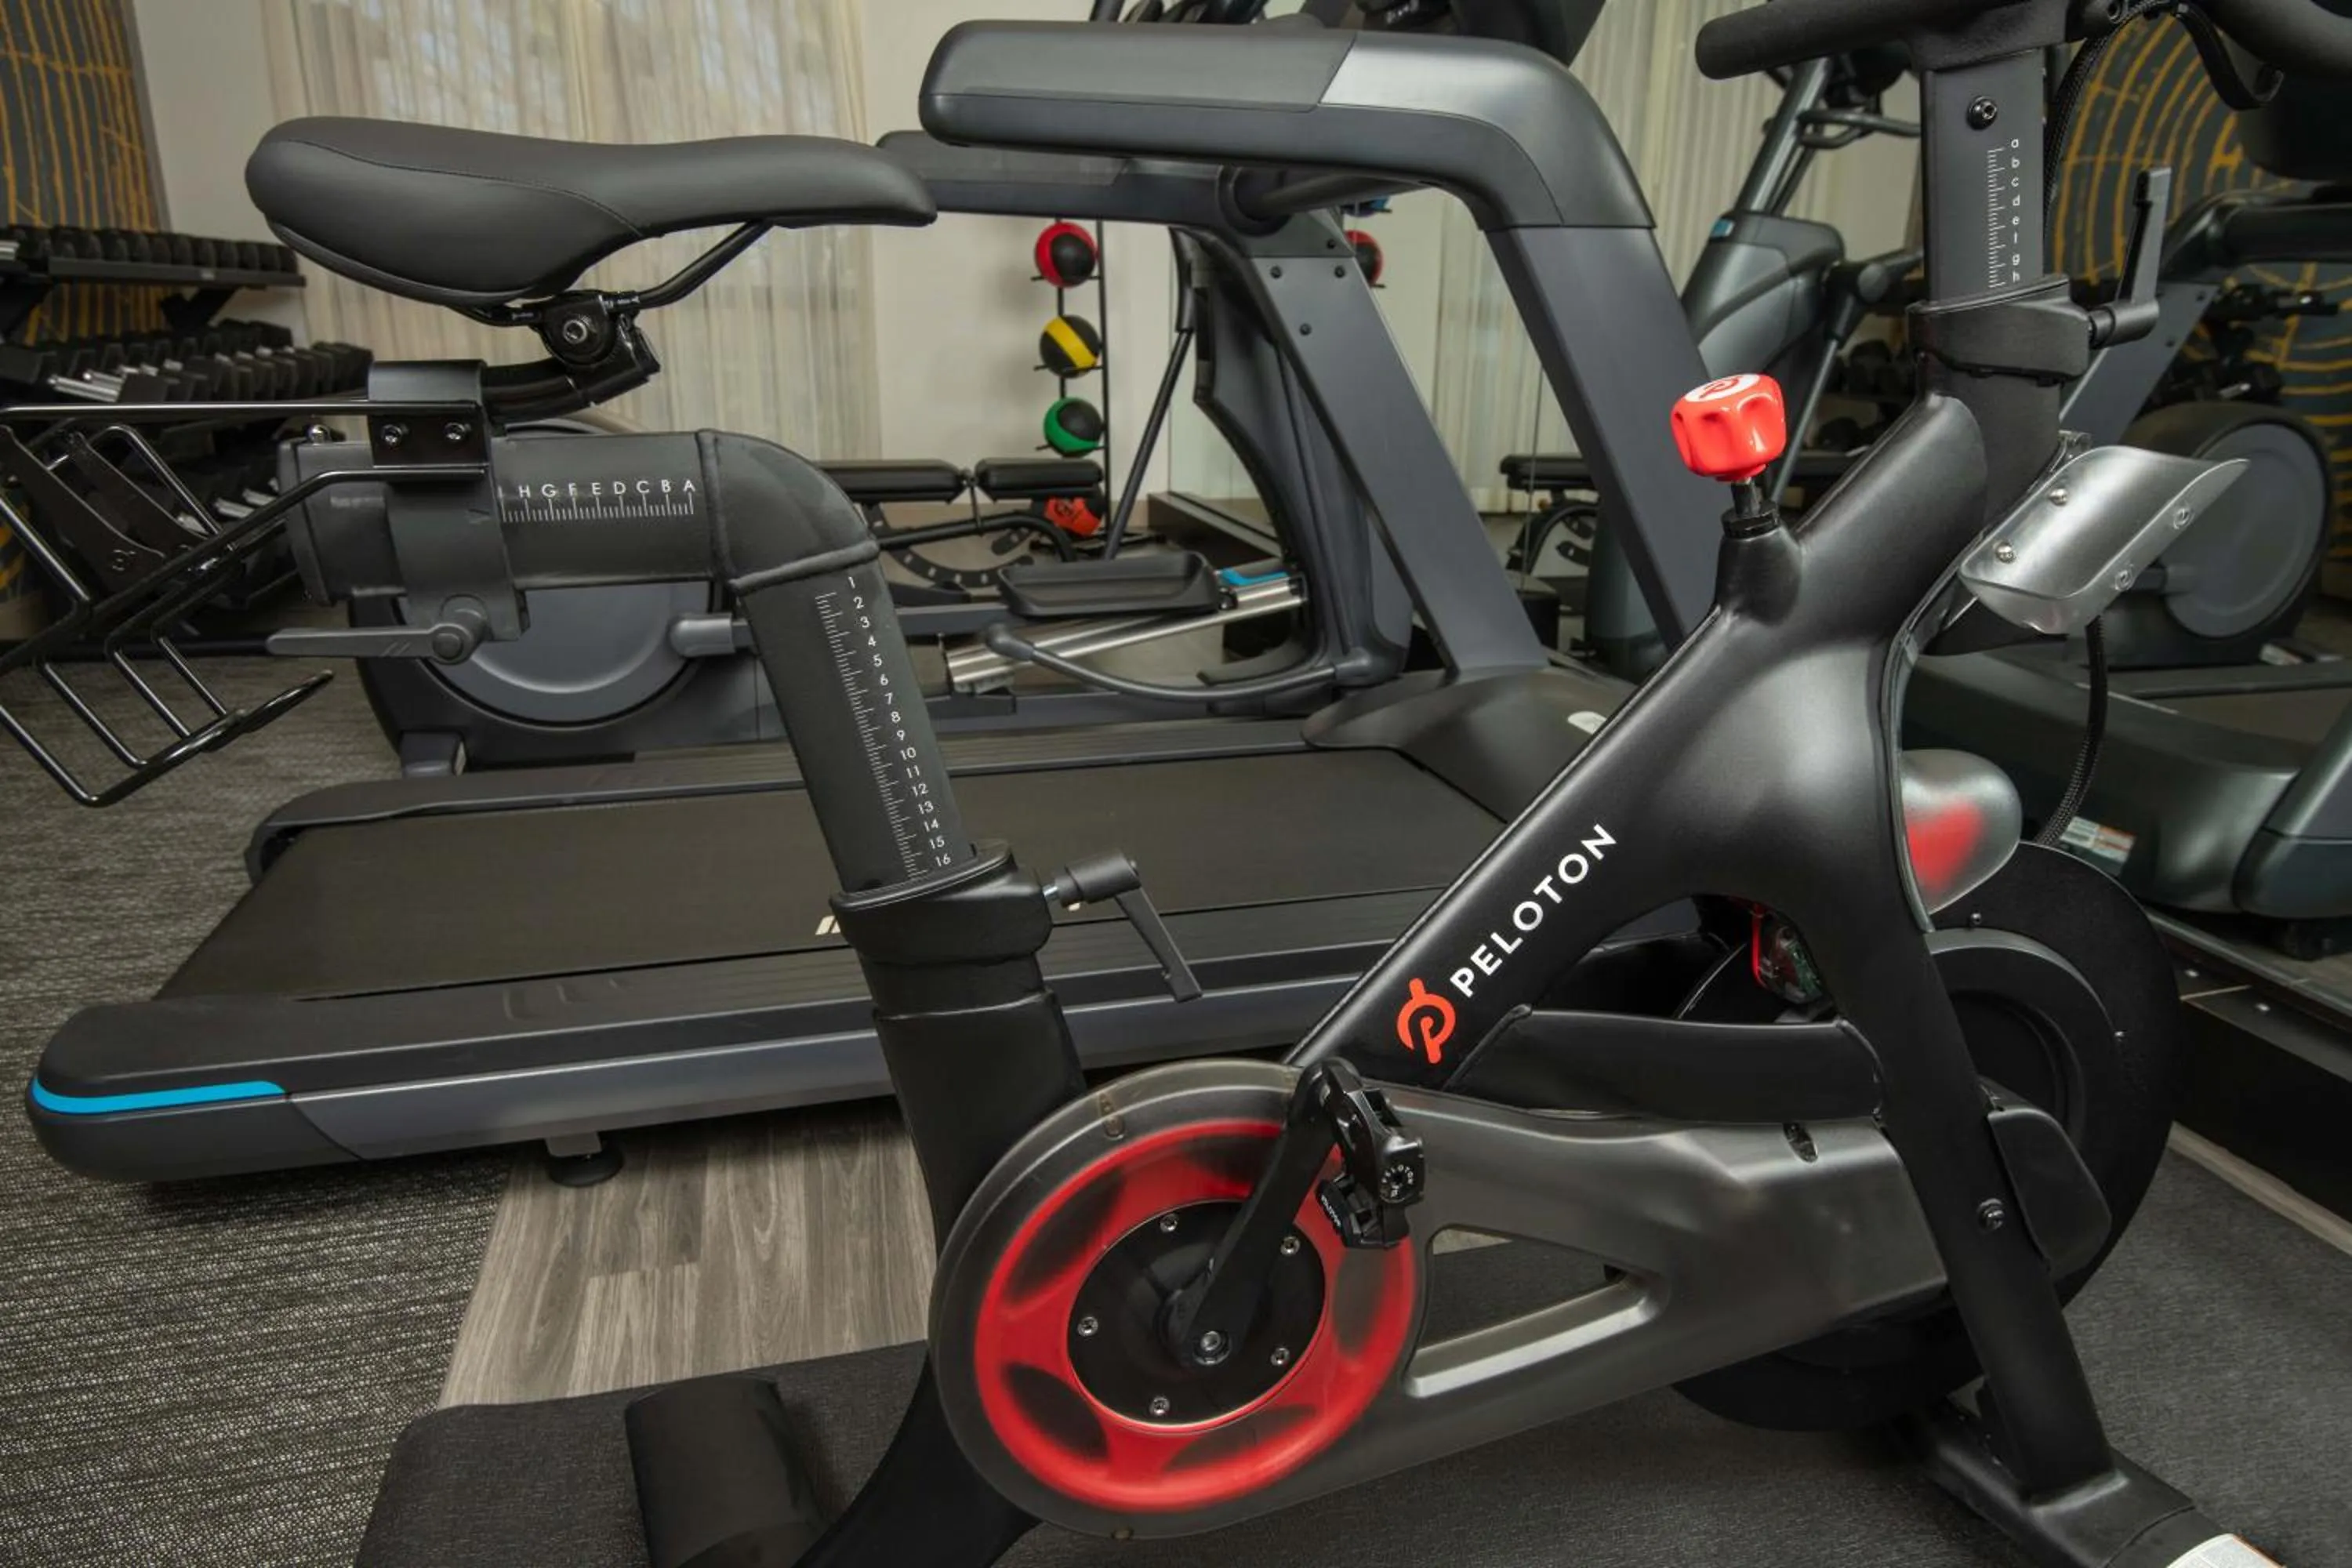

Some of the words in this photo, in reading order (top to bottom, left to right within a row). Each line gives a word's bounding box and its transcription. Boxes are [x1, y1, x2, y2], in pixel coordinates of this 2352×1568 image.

[2010, 138, 2020, 149] a
[2011, 157, 2020, 169] b
[2010, 176, 2020, 187] c
[2012, 194, 2020, 207] d
[2011, 216, 2020, 226] e
[518, 485, 531, 498] H
[541, 483, 558, 498] G
[568, 482, 577, 496] F
[591, 482, 601, 495] E
[613, 481, 626, 495] D
[636, 480, 650, 495] C
[661, 479, 671, 493] B
[683, 479, 695, 492] A
[848, 576, 856, 589] 1
[853, 596, 865, 609] 2
[859, 615, 870, 629] 3
[867, 635, 877, 647] 4
[873, 653, 883, 667] 5
[880, 673, 889, 686] 6
[884, 691, 893, 705] 7
[890, 710, 902, 724] 8
[896, 729, 906, 741] 9
[900, 746, 916, 760] 10
[906, 764, 920, 779] 11
[912, 782, 929, 797] 12
[917, 800, 935, 815] 13
[924, 818, 939, 832] 14
[929, 835, 946, 850] 15
[935, 853, 952, 867] 16
[1450, 823, 1617, 998] PELOTON
